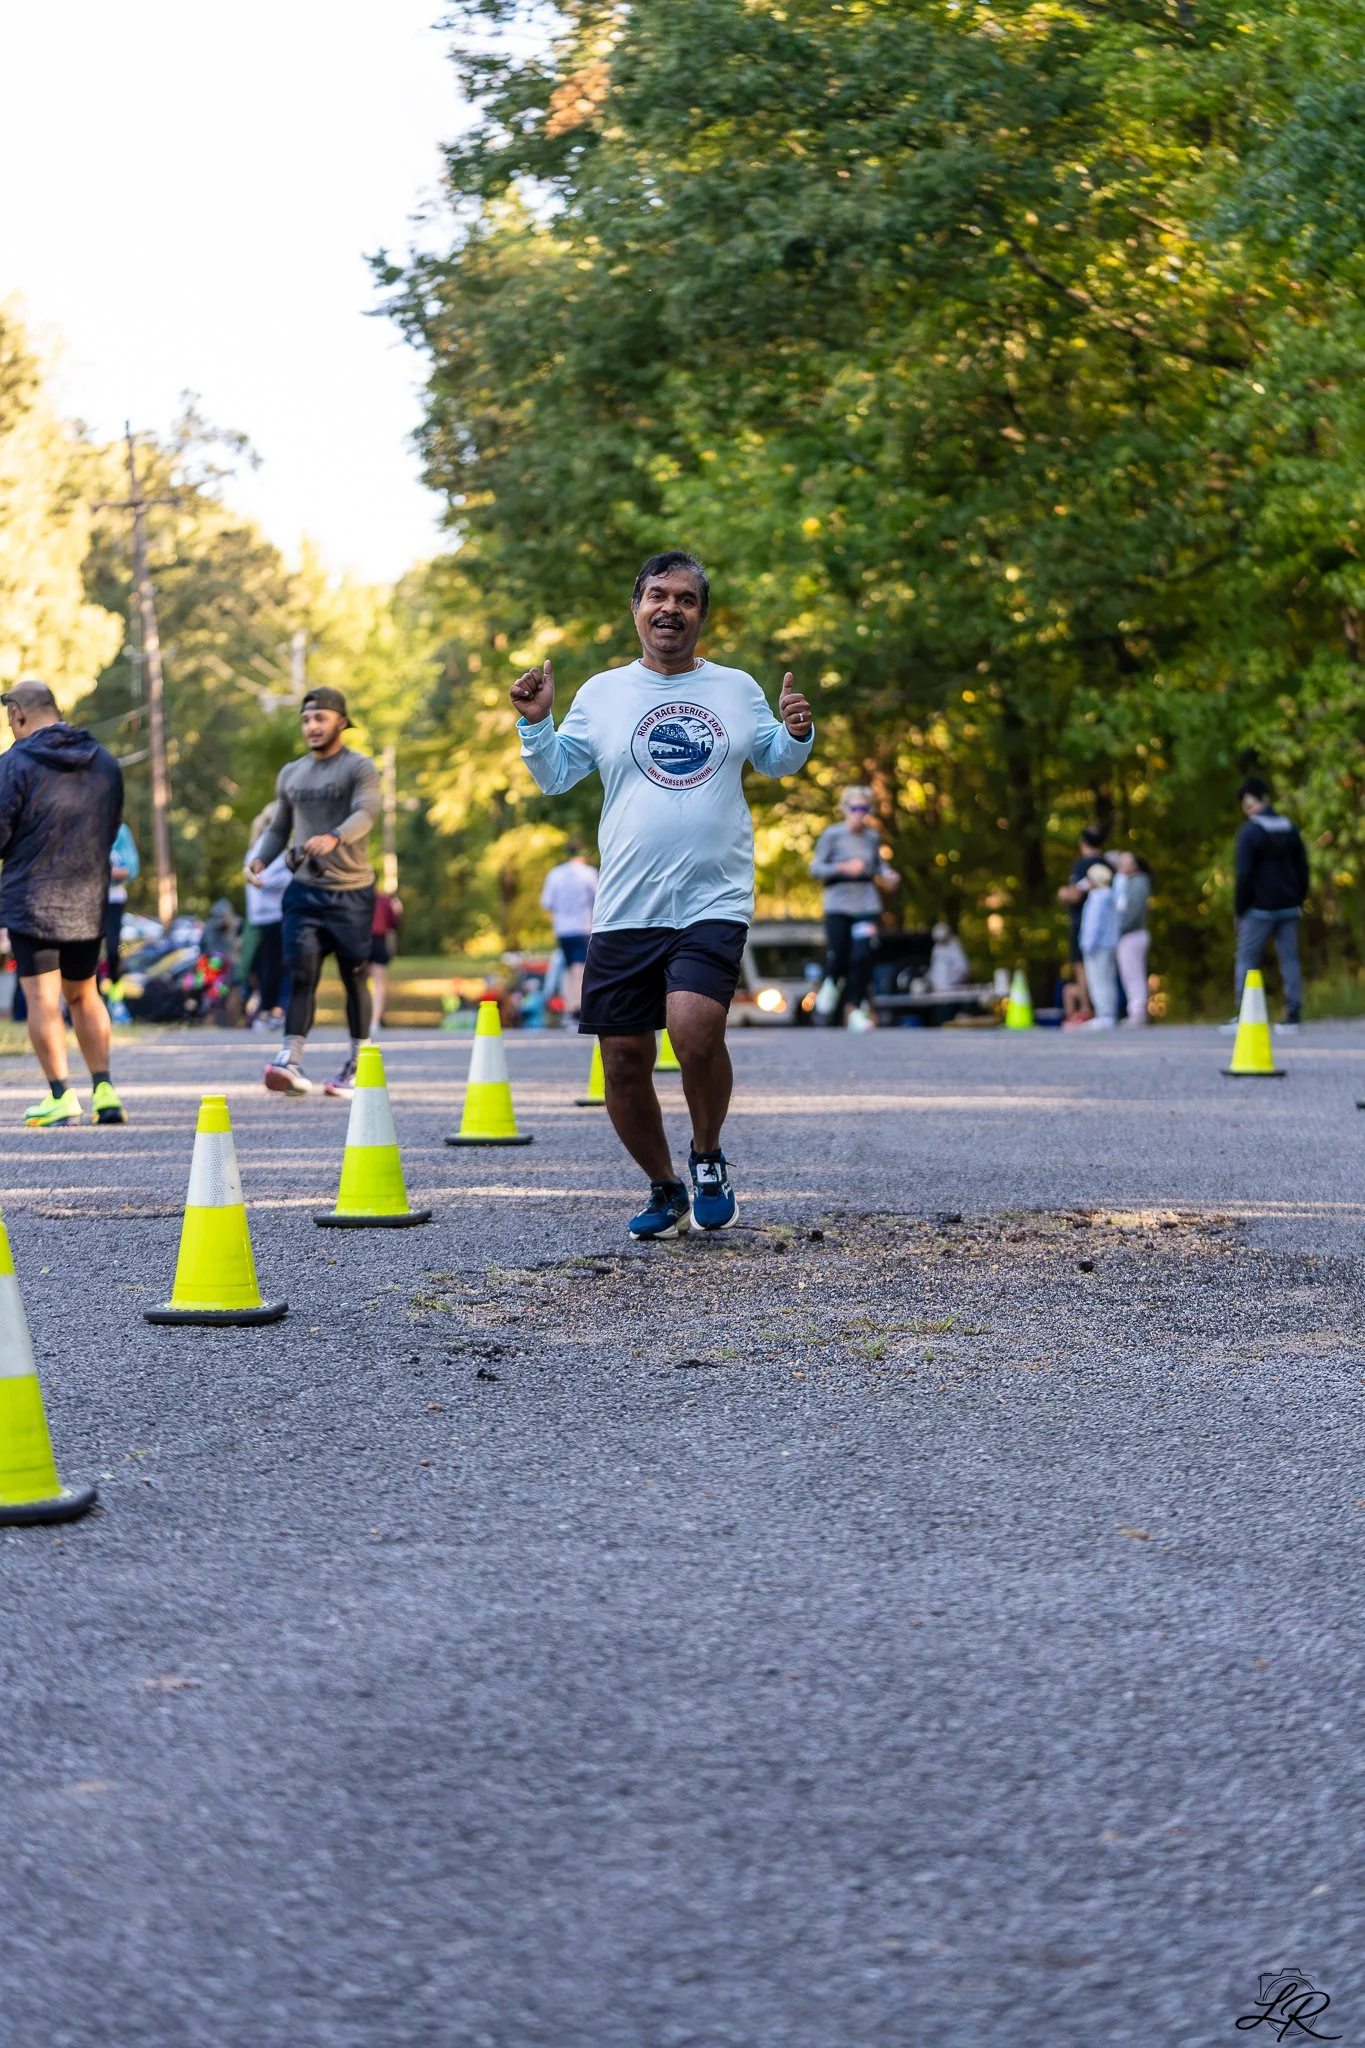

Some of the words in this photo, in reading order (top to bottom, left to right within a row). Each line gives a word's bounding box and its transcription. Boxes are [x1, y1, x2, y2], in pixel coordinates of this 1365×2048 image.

[637, 717, 655, 737] ROAD
[654, 706, 677, 720] RACE
[679, 705, 709, 720] SERIES
[708, 718, 725, 737] 2026
[647, 766, 662, 781] LANE
[660, 777, 684, 786] PURSER
[685, 766, 713, 786] MEMORIAL
